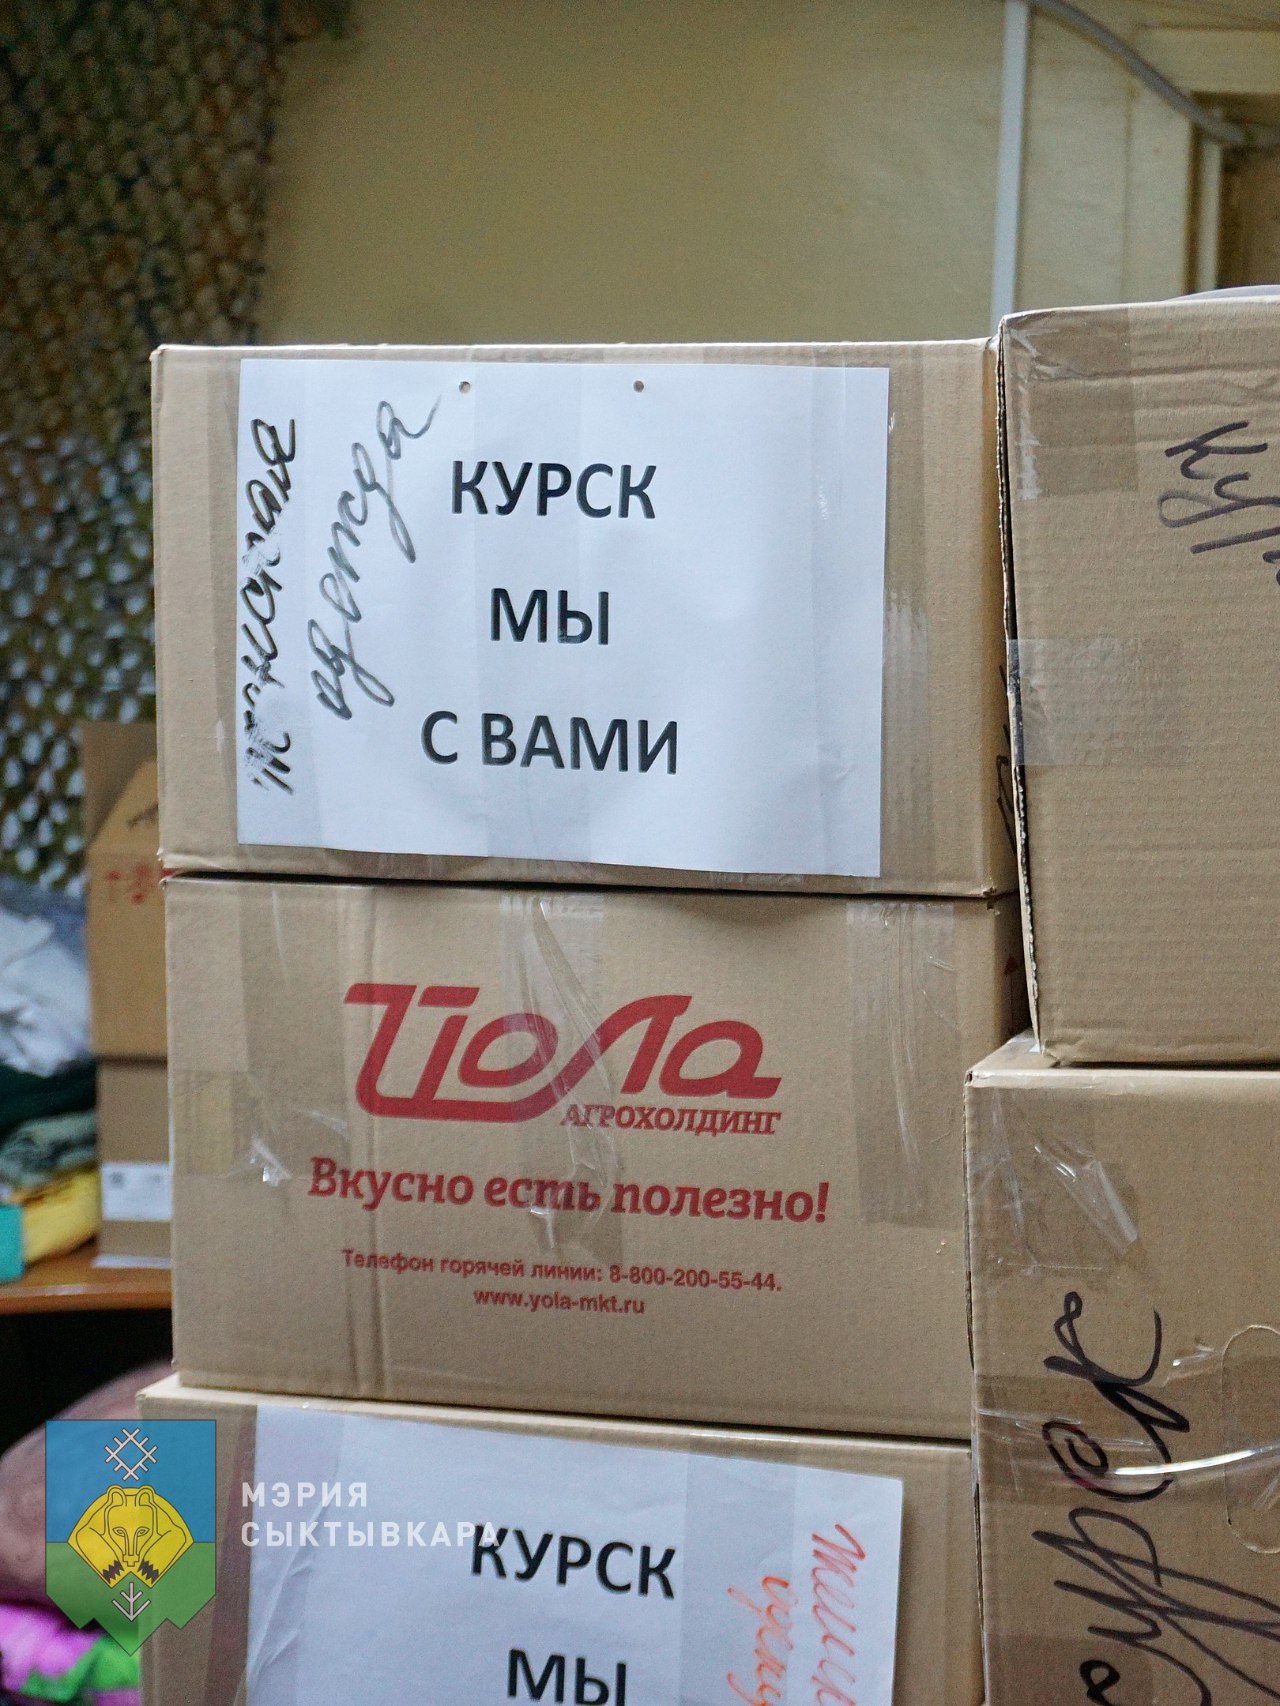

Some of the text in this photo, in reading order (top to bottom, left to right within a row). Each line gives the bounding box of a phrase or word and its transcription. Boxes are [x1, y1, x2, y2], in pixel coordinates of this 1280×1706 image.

[452, 461, 658, 519] КУРСК
[490, 588, 609, 645] МЫ
[421, 710, 678, 775] С ВАМИ
[308, 1156, 830, 1224] Вкусно есть полезно!
[342, 1248, 783, 1294] Телефон горячей линии: 8-800-200-55-44.
[473, 1287, 645, 1317] www.yola-mkt.ru
[470, 1525, 677, 1599] КУРСК
[508, 1649, 626, 1706] МЫ
